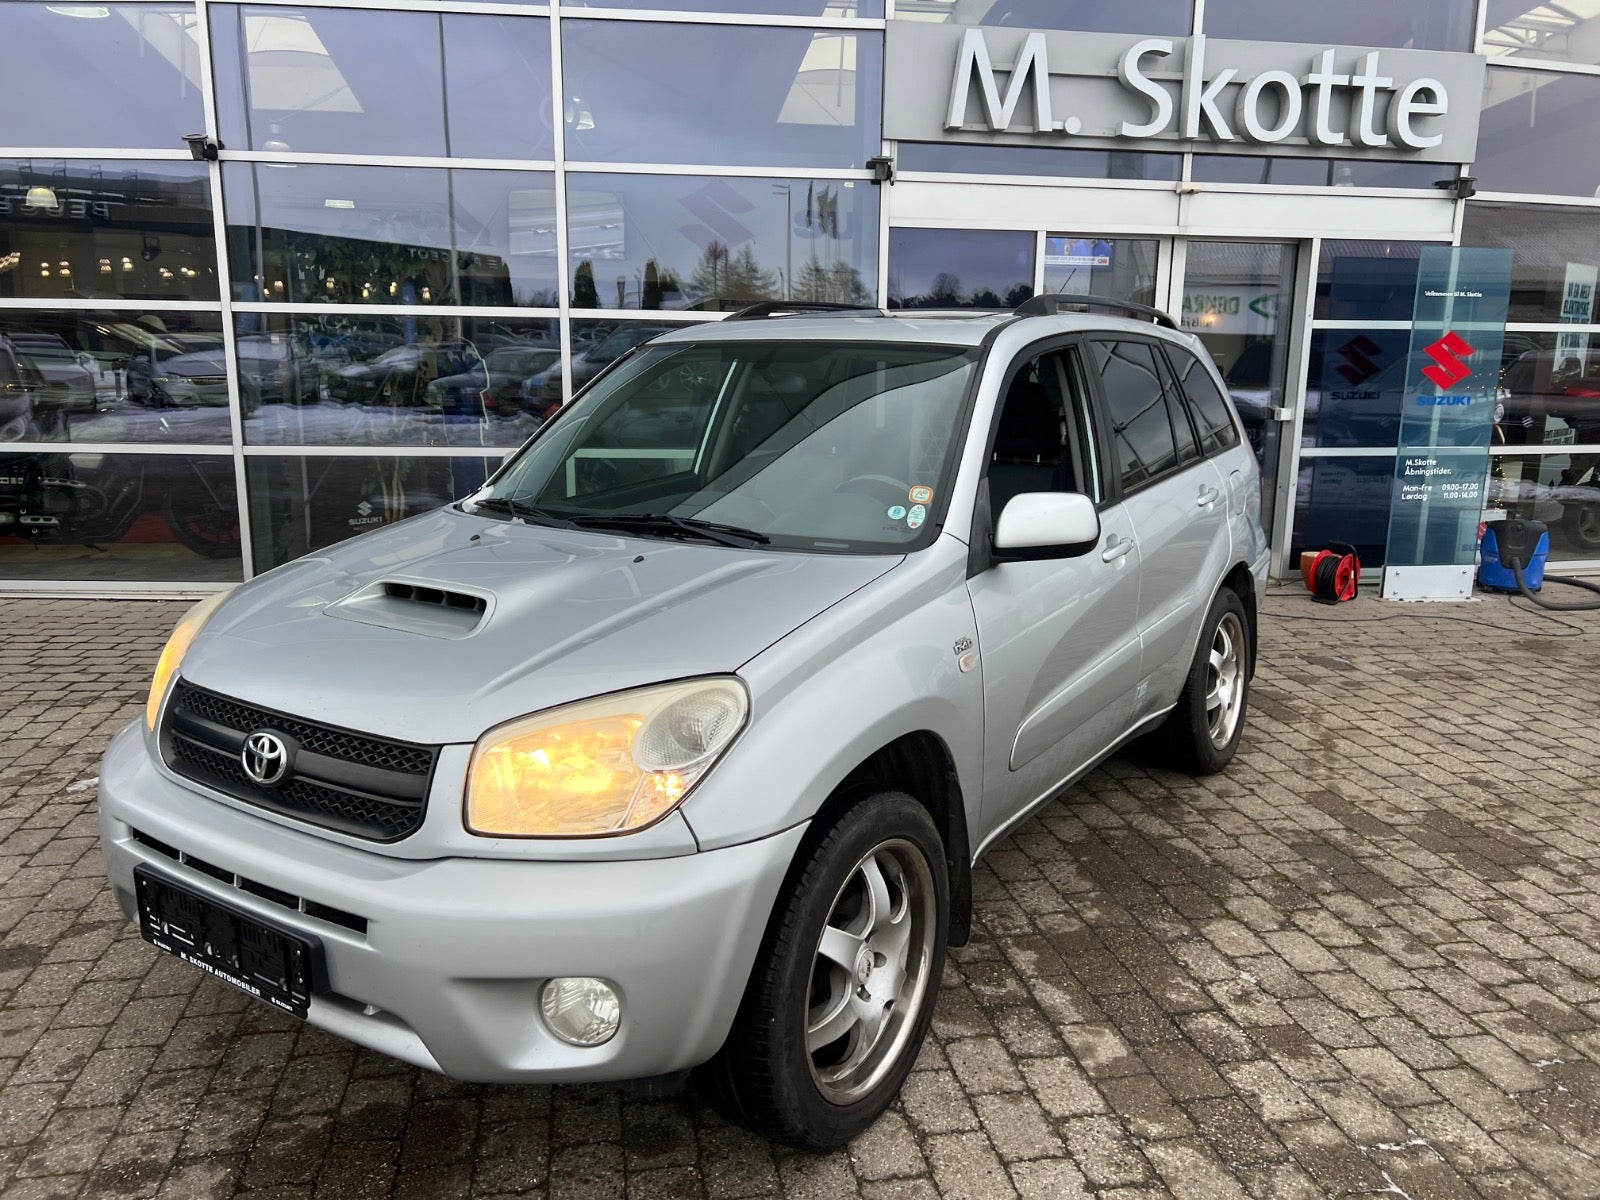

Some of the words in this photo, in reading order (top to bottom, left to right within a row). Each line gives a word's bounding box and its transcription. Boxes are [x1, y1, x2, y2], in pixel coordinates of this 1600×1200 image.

[943, 28, 1082, 133] M.
[1114, 33, 1450, 151] Skotte
[1331, 391, 1381, 401] SUZUKI
[1416, 395, 1471, 406] SUZUKI
[1402, 484, 1433, 492] Man-fre
[1401, 493, 1428, 501] Lørdag
[348, 516, 383, 526] SUZUKI
[189, 955, 213, 974] SKOTTE
[214, 968, 261, 997] AUTOMOBILER
